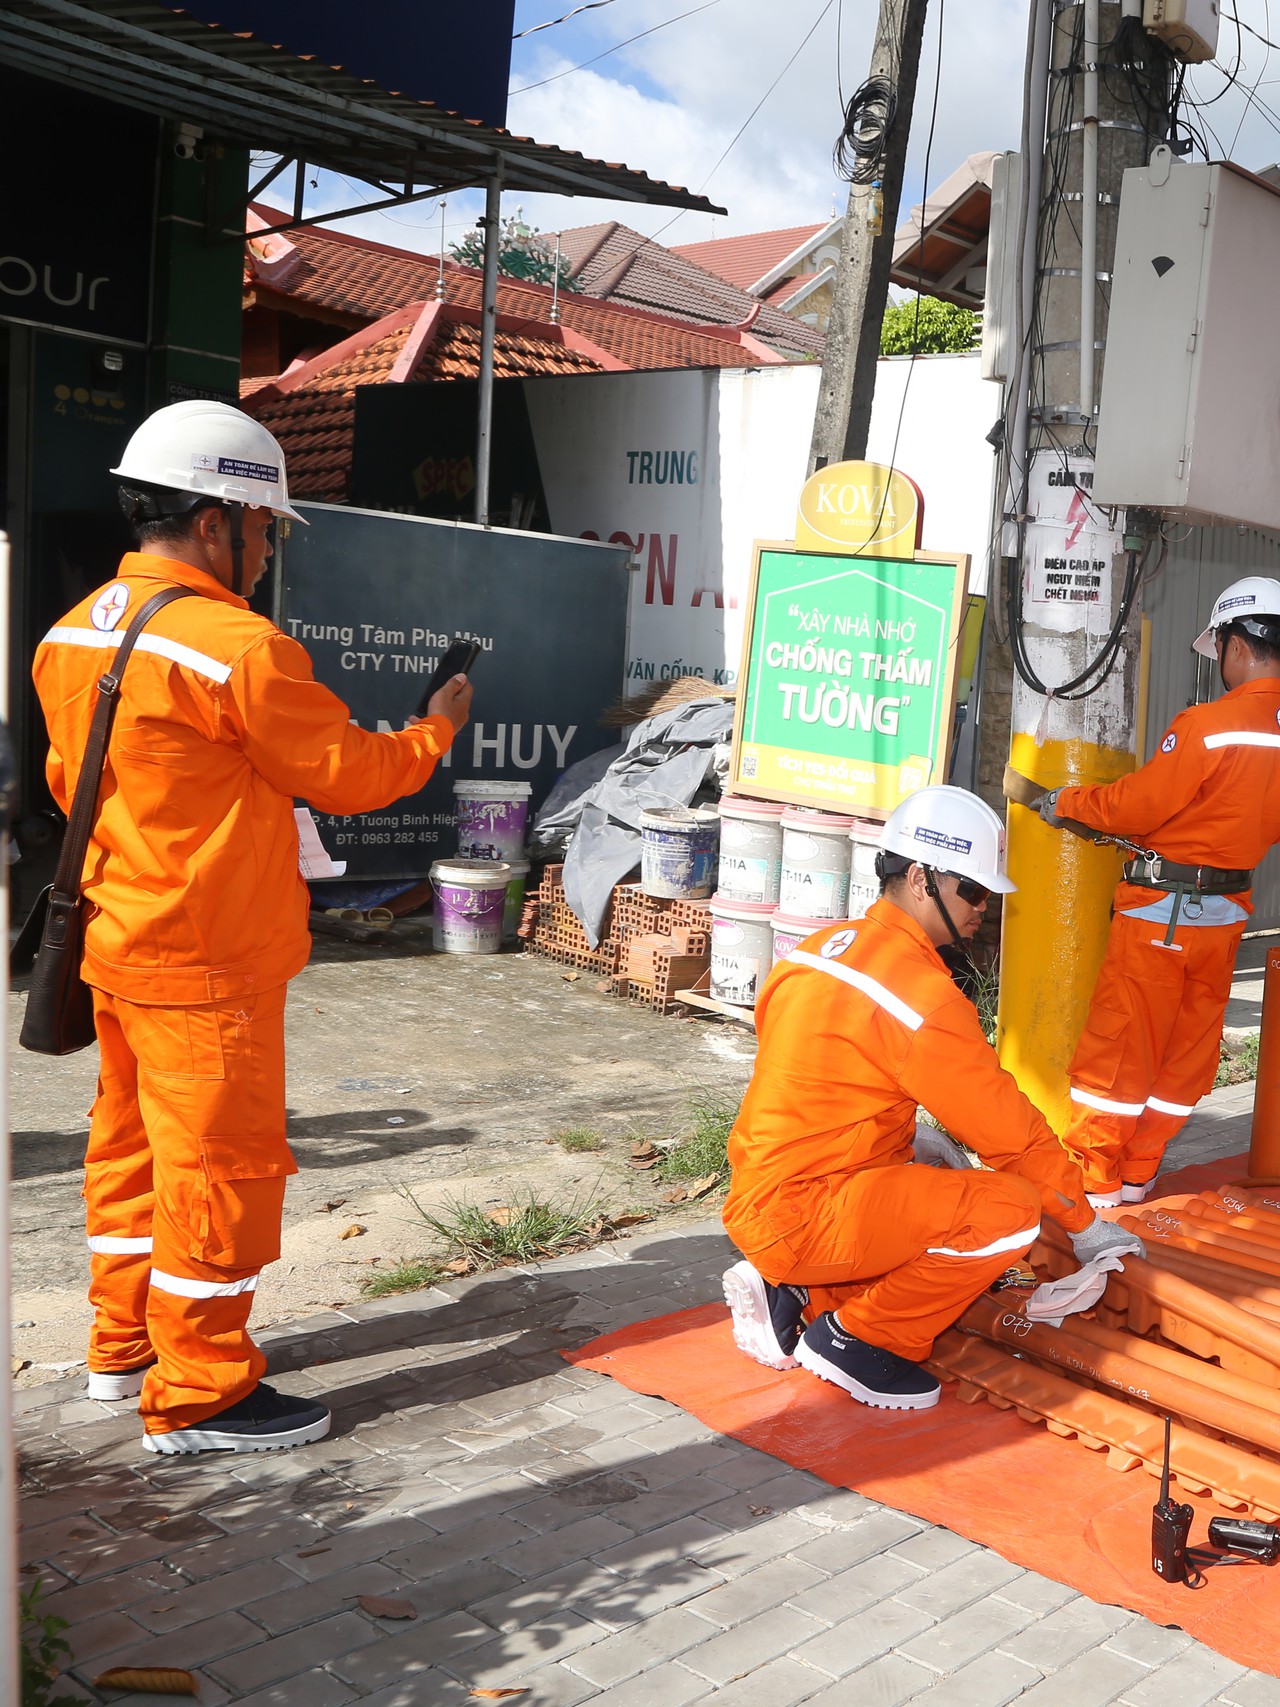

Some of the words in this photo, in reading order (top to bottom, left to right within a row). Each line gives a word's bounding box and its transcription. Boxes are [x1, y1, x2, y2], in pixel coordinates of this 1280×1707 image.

[421, 458, 470, 495] SPEC
[626, 450, 699, 485] TRUNG
[816, 483, 897, 517] KOVA
[1046, 573, 1073, 585] NGUY
[1044, 586, 1068, 600] CHẾT
[287, 618, 353, 647] Trung
[360, 623, 405, 645] Tâm
[412, 628, 449, 648] Pha
[833, 612, 871, 638] NHÀ
[875, 617, 916, 643] NHỚ
[340, 651, 385, 672] CTY
[765, 637, 853, 676] CHỐNG
[859, 647, 933, 687] THẤM
[473, 722, 578, 769] HUY
[343, 815, 356, 827] P.
[336, 833, 359, 845] ĐT:
[362, 832, 391, 845] 0963
[393, 832, 415, 844] 282
[418, 831, 439, 843] 455
[1002, 1314, 1034, 1337] 079
[1153, 1557, 1164, 1573] 15
